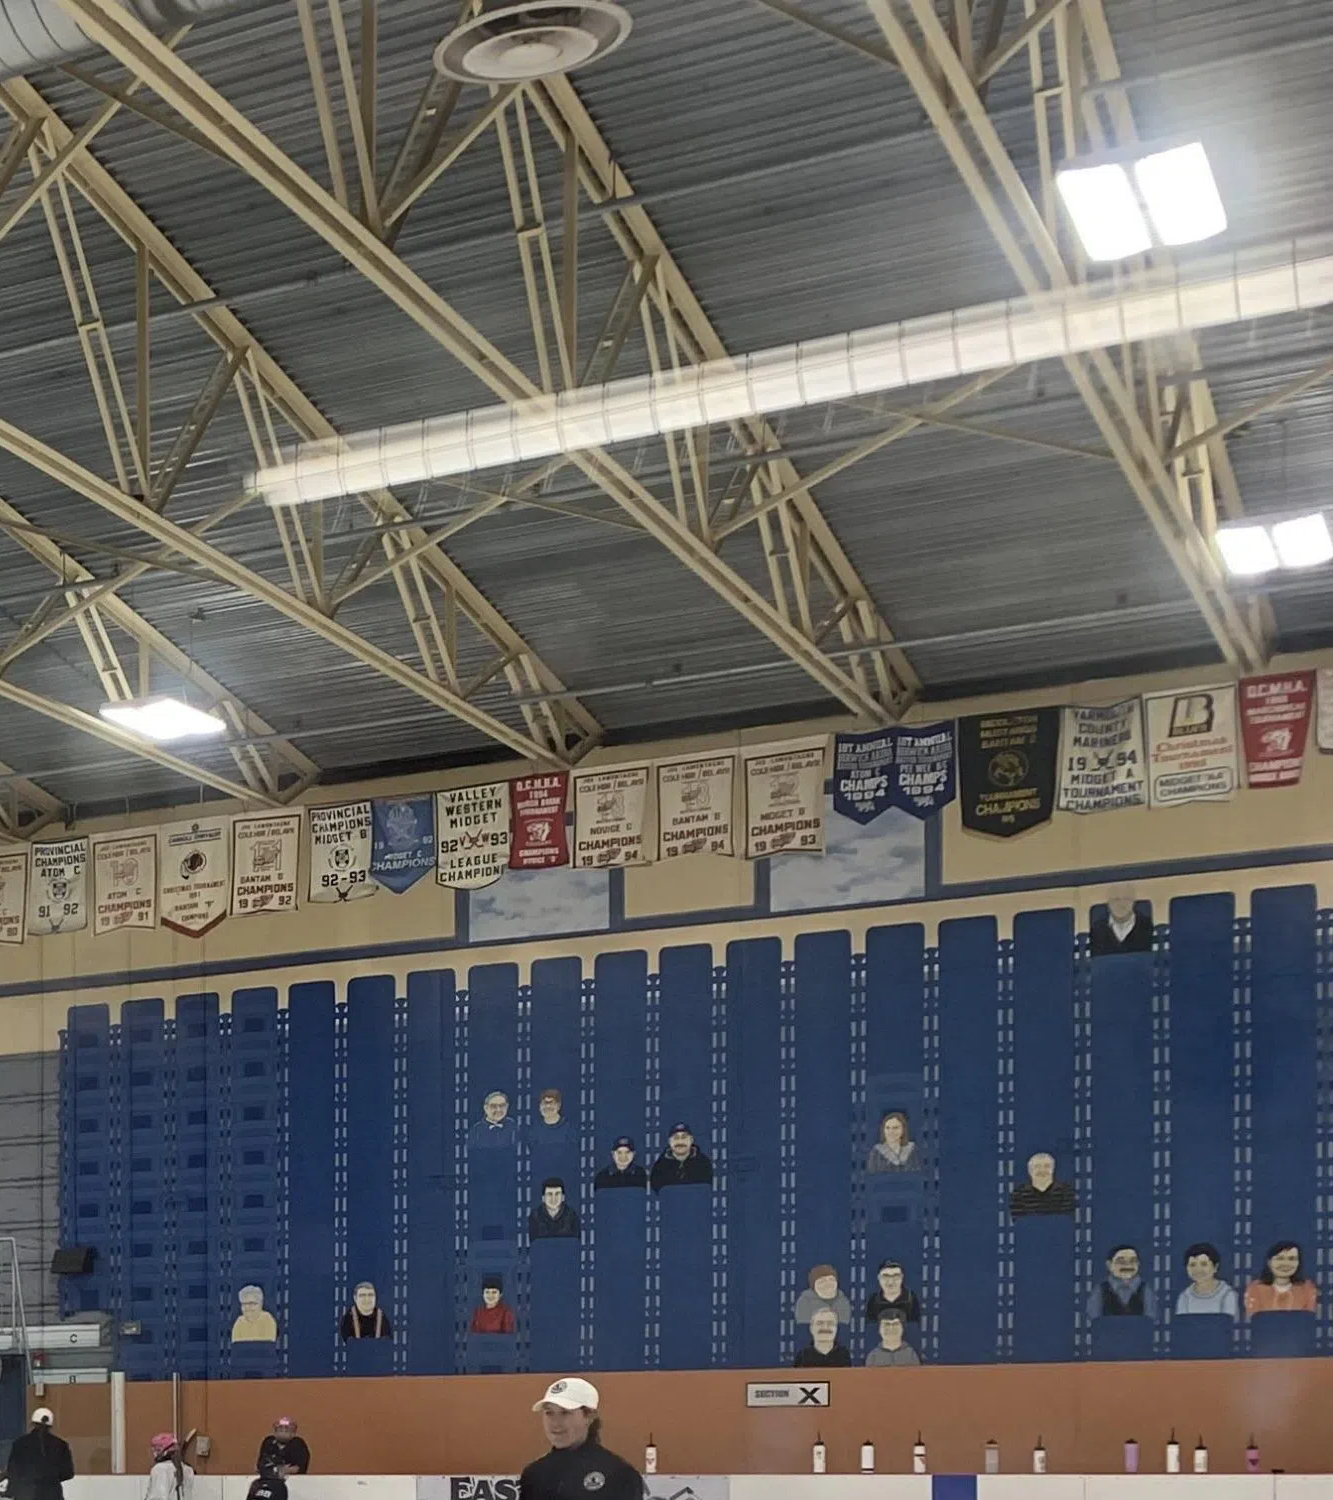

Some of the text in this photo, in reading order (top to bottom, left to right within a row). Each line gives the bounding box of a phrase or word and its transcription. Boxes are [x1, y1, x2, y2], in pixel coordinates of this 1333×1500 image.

[840, 775, 888, 792] CHAMPS
[899, 770, 947, 786] CHAMPS
[1071, 768, 1133, 785] MIDGET A
[450, 787, 497, 803] VALLEY
[1064, 781, 1143, 798] TOURNAMENT
[445, 798, 502, 816] WESTERN
[1066, 794, 1145, 810] CHAMPIONS
[312, 804, 370, 821] PROVINCIAL
[450, 812, 497, 828] MIDGET
[672, 815, 708, 826] BANTAM
[312, 816, 372, 833] CHAMPIONS
[751, 818, 820, 837] CHAMPIONS
[315, 831, 351, 845] MIDGET
[663, 824, 728, 842] CHAMPIONS
[35, 842, 86, 856] PROVINCIAL
[441, 832, 508, 853] 92 93
[578, 835, 642, 851] CHAMPIONS
[754, 834, 816, 852] 19 93
[666, 846, 678, 857] 19
[35, 854, 86, 867] CHAMPIONS
[450, 853, 499, 869] LEAGUE
[582, 856, 593, 866] 19
[41, 865, 81, 878] ATOM C
[240, 874, 271, 884] BANTAM
[321, 870, 366, 887] 92-93
[237, 883, 294, 896] CHAMPIONS
[98, 899, 152, 914] CHAMPIONS
[278, 896, 291, 905] 92
[38, 903, 79, 918] 91 92
[138, 912, 149, 921] 91
[70, 1333, 78, 1343] C
[755, 1388, 821, 1404] SECTION X
